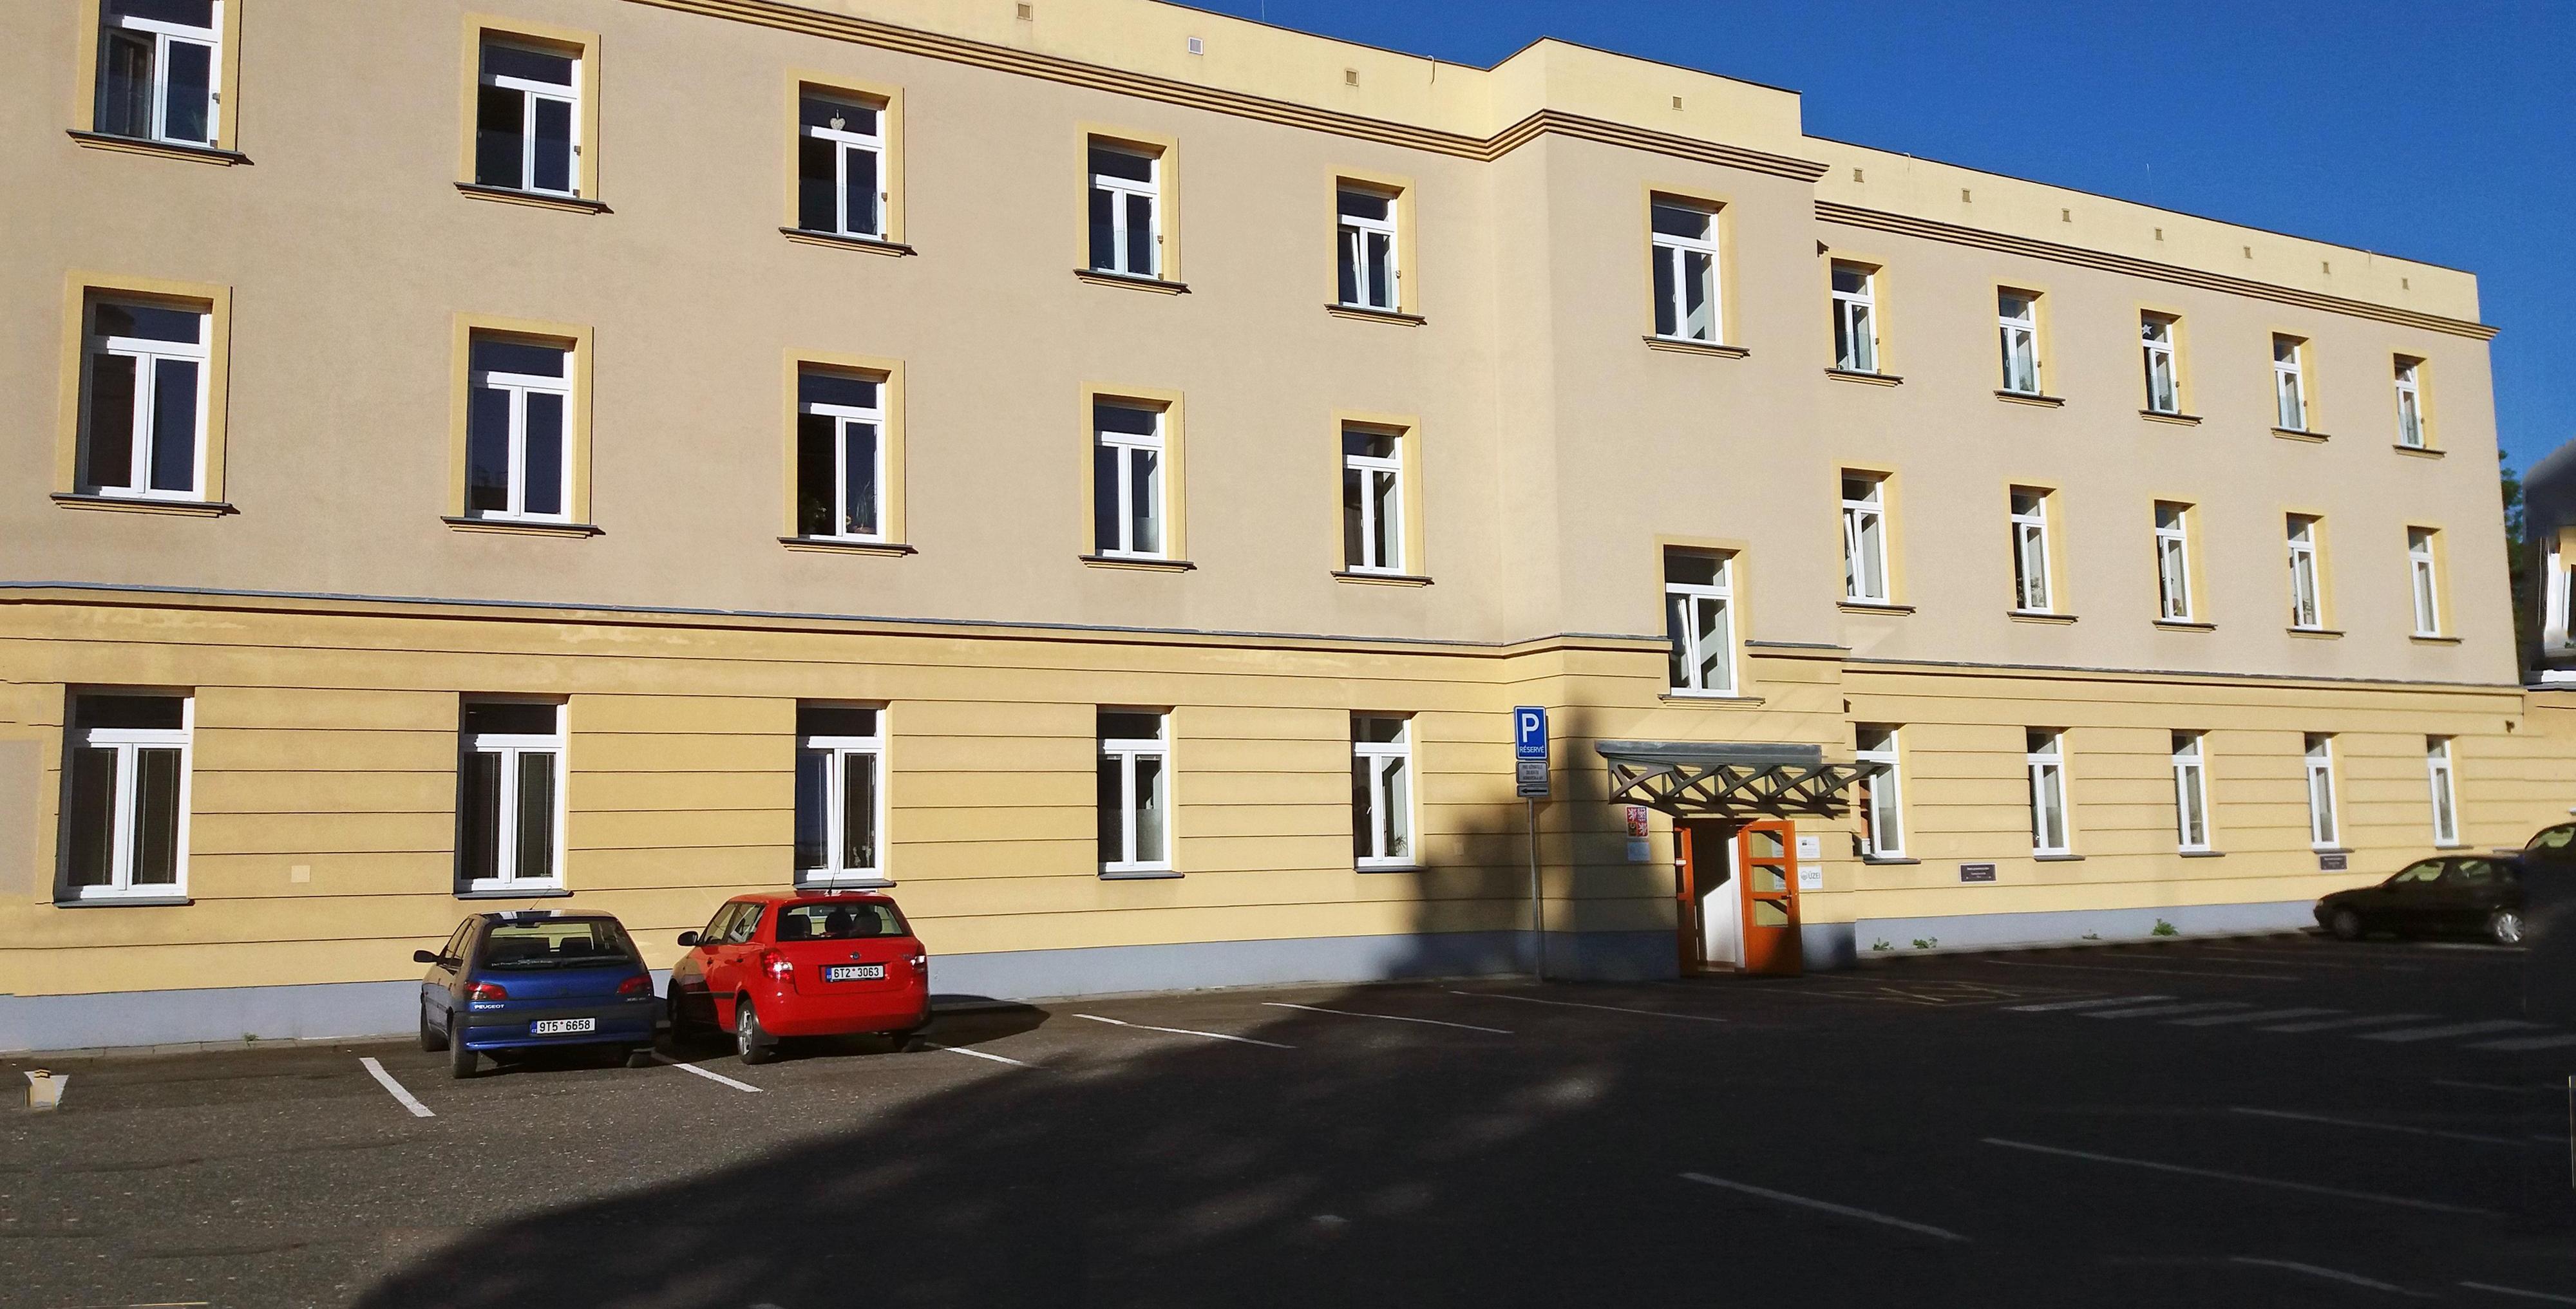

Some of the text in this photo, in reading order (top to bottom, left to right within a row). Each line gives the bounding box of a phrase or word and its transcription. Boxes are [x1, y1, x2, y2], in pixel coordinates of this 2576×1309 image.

[1522, 713, 1540, 742] P
[1520, 745, 1545, 753] RÉSERVÉ
[834, 967, 879, 978] 6T2 3063
[540, 1020, 591, 1032] 9T5 6658
